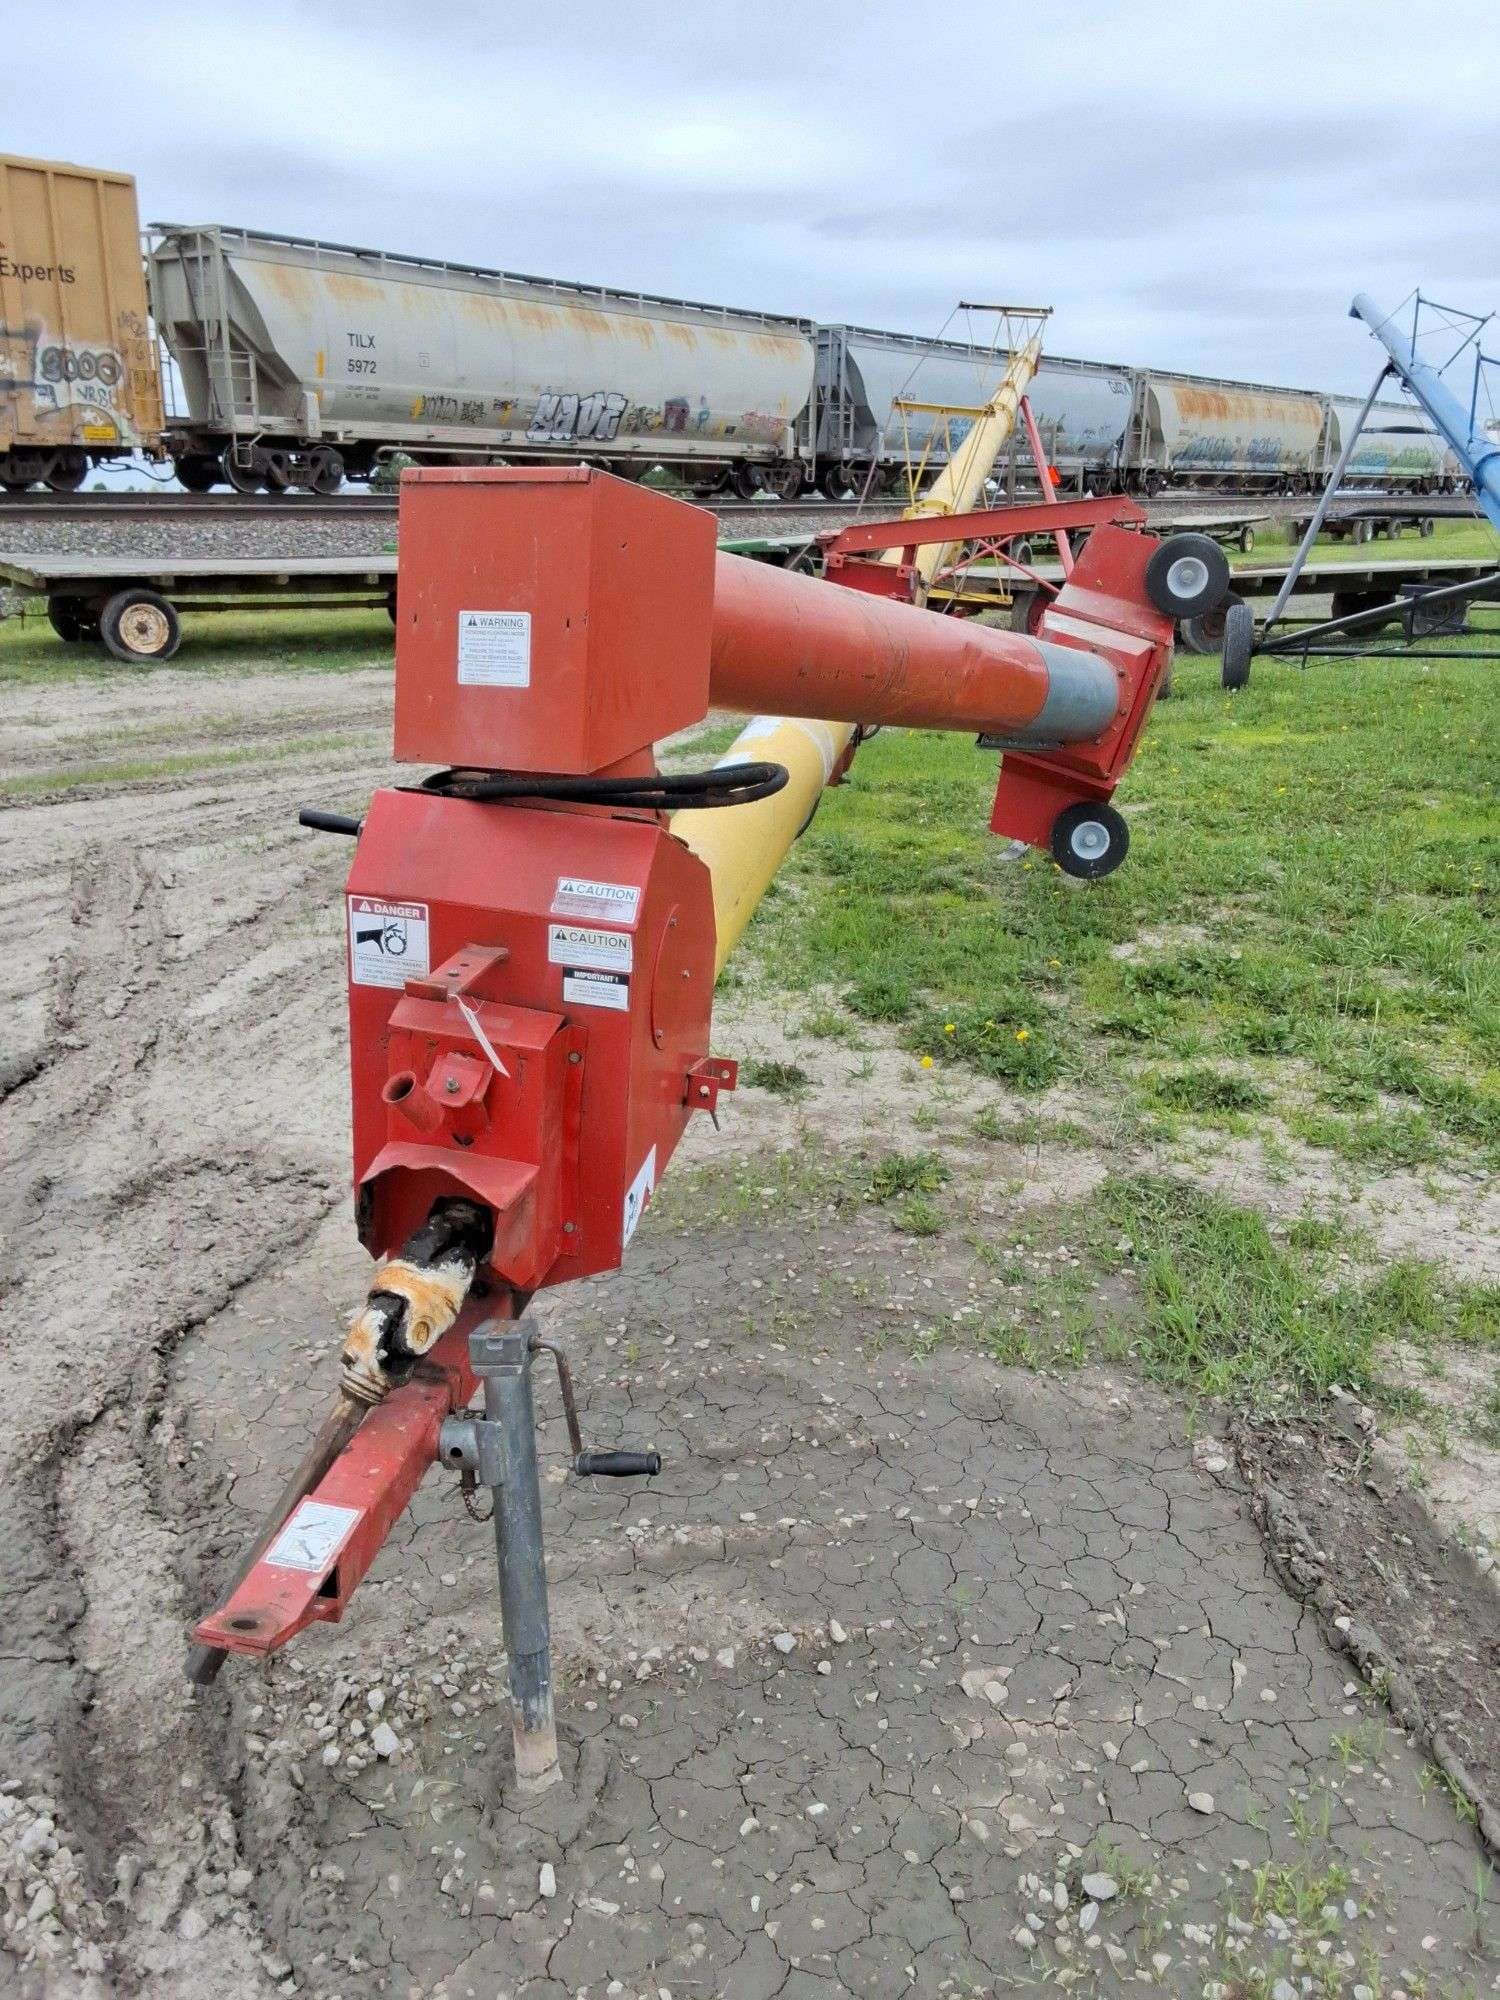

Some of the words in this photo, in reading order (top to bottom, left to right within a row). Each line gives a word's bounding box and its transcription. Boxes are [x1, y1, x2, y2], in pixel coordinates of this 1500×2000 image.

[0, 256, 76, 284] Experts
[346, 333, 376, 349] TILX
[347, 358, 377, 374] 5972
[480, 617, 524, 628] WARNING
[576, 884, 635, 901] CAUTION
[374, 903, 420, 918] DANGER
[569, 932, 627, 948] CAUTION
